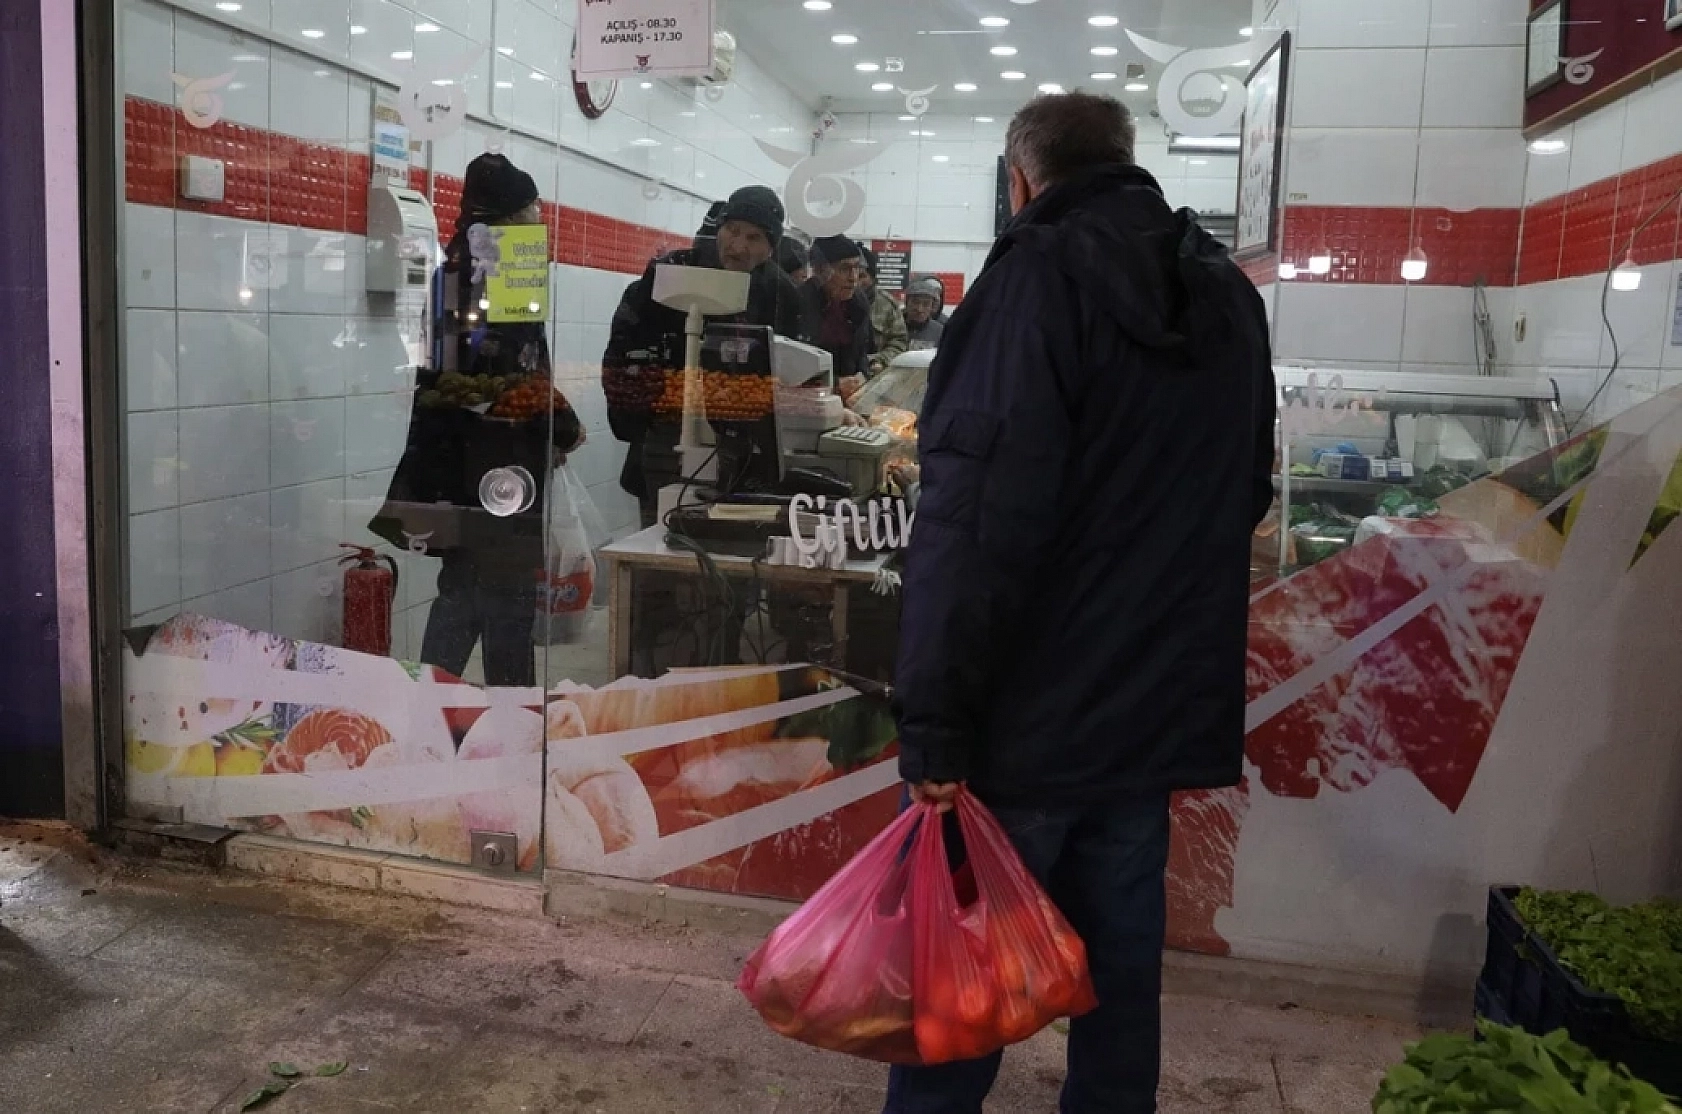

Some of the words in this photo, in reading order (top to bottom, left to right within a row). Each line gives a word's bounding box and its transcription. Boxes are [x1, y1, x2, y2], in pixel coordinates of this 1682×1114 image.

[606, 18, 637, 31] AÇILIŞ
[647, 18, 676, 28] 08.30
[600, 32, 644, 44] KAPANIŞ
[653, 32, 682, 42] 17.30
